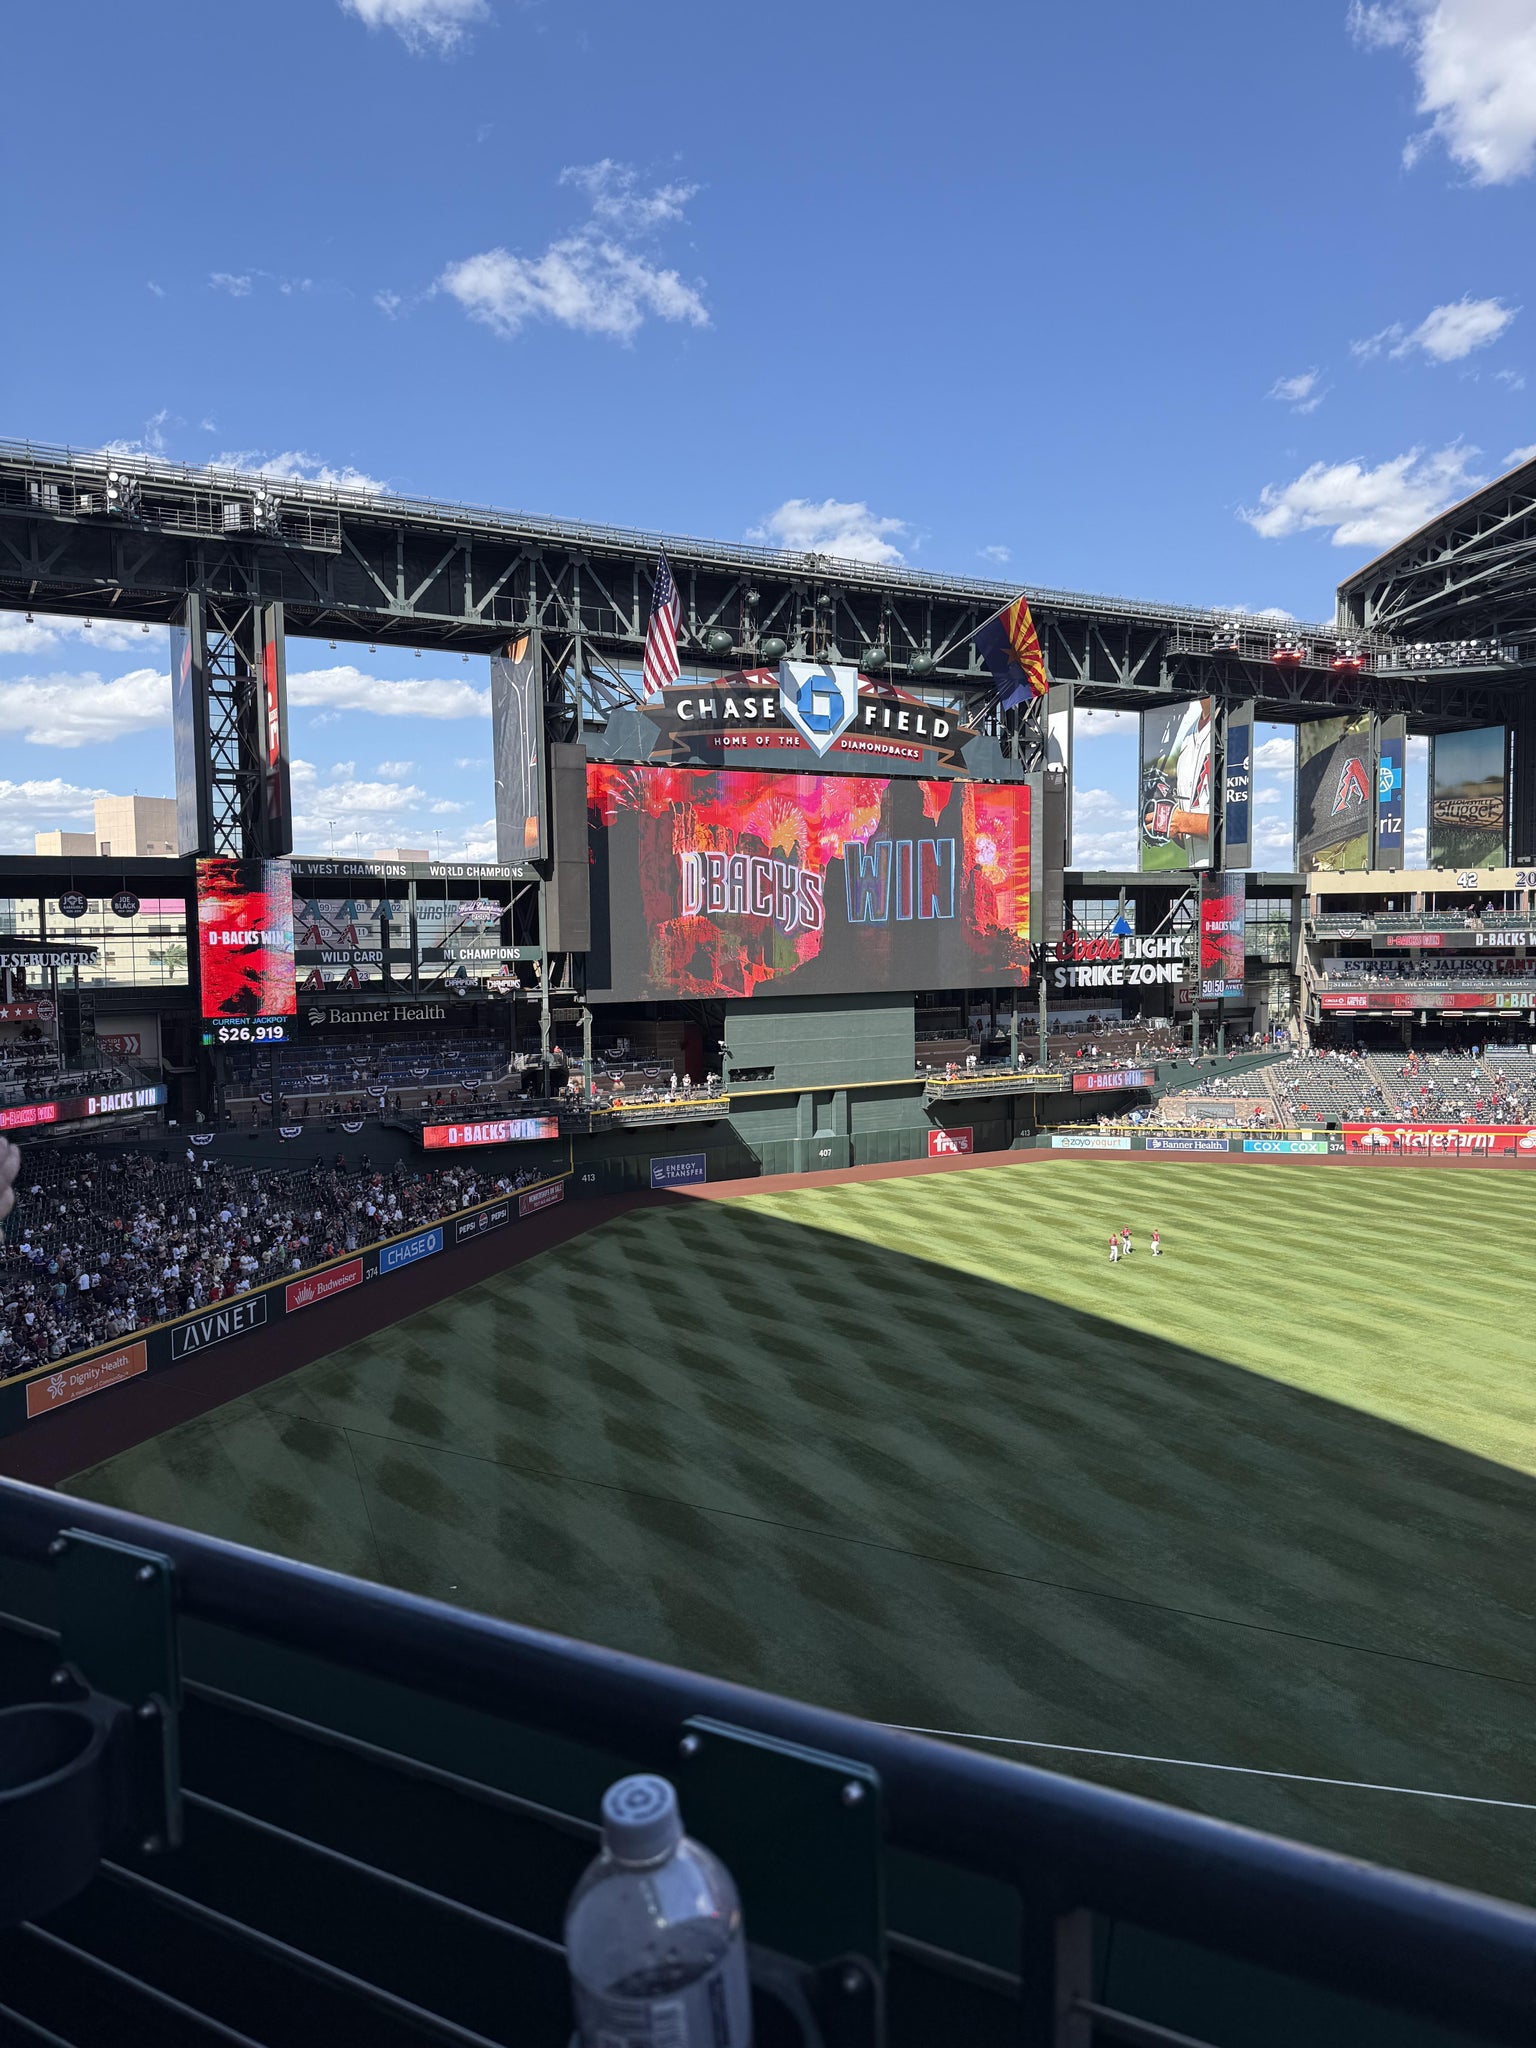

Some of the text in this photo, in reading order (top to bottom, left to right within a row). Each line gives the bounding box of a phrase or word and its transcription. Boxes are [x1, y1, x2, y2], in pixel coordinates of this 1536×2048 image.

[676, 697, 950, 738] CHASE FIELD
[714, 736, 920, 759] HOME OF THE DIAMONDBACKS
[1436, 801, 1498, 823] Slugger
[1380, 813, 1402, 834] riz
[291, 864, 406, 876] NL WEST CHAMPIONS
[430, 866, 523, 877] WORLD CHAMPIONS
[842, 838, 955, 922] WIN
[1457, 872, 1478, 888] 42
[1515, 871, 1536, 887] 20
[358, 928, 366, 936] 11
[1205, 921, 1228, 931] D-BACKS
[209, 930, 285, 945] D-BACKS WIN
[1056, 929, 1184, 961] Coors LIGHT
[1387, 936, 1421, 945] D-BACKS
[1476, 933, 1525, 946] D-BACKS
[1, 951, 98, 968] ESEBURGERS
[321, 951, 383, 962] WILD CARD
[443, 949, 520, 960] NL CHAMPIONS
[1433, 959, 1493, 970] JALISCO
[1054, 963, 1183, 988] STRIKE ZONE
[487, 979, 521, 990] CHAMPIONS
[212, 1016, 288, 1026] CURRENT JACKPOT
[329, 1005, 446, 1023] Banner Health
[218, 1026, 284, 1043] $26,919
[1087, 1071, 1142, 1088] D-BACKS WIN
[88, 1088, 156, 1114] D-BACKS WIN
[0, 1105, 55, 1126] D-BACKS WIN
[448, 1120, 536, 1144] D-BACKS WIN
[933, 1132, 969, 1152] fry's
[1162, 1140, 1223, 1149] Banner Health
[1254, 1142, 1317, 1152] COX COX
[1329, 1143, 1344, 1151] 374
[818, 1149, 832, 1157] 407
[666, 1163, 696, 1172] ENERGY
[667, 1168, 703, 1179] TRANSFER
[581, 1174, 596, 1182] 413
[458, 1222, 476, 1235] PEPSI
[490, 1209, 507, 1222] PEPSI
[388, 1239, 426, 1265] CHASE
[366, 1267, 378, 1280] 374
[317, 1271, 357, 1295] Budweiser
[183, 1301, 258, 1351] AVNET
[70, 1355, 129, 1386] Dignity Health
